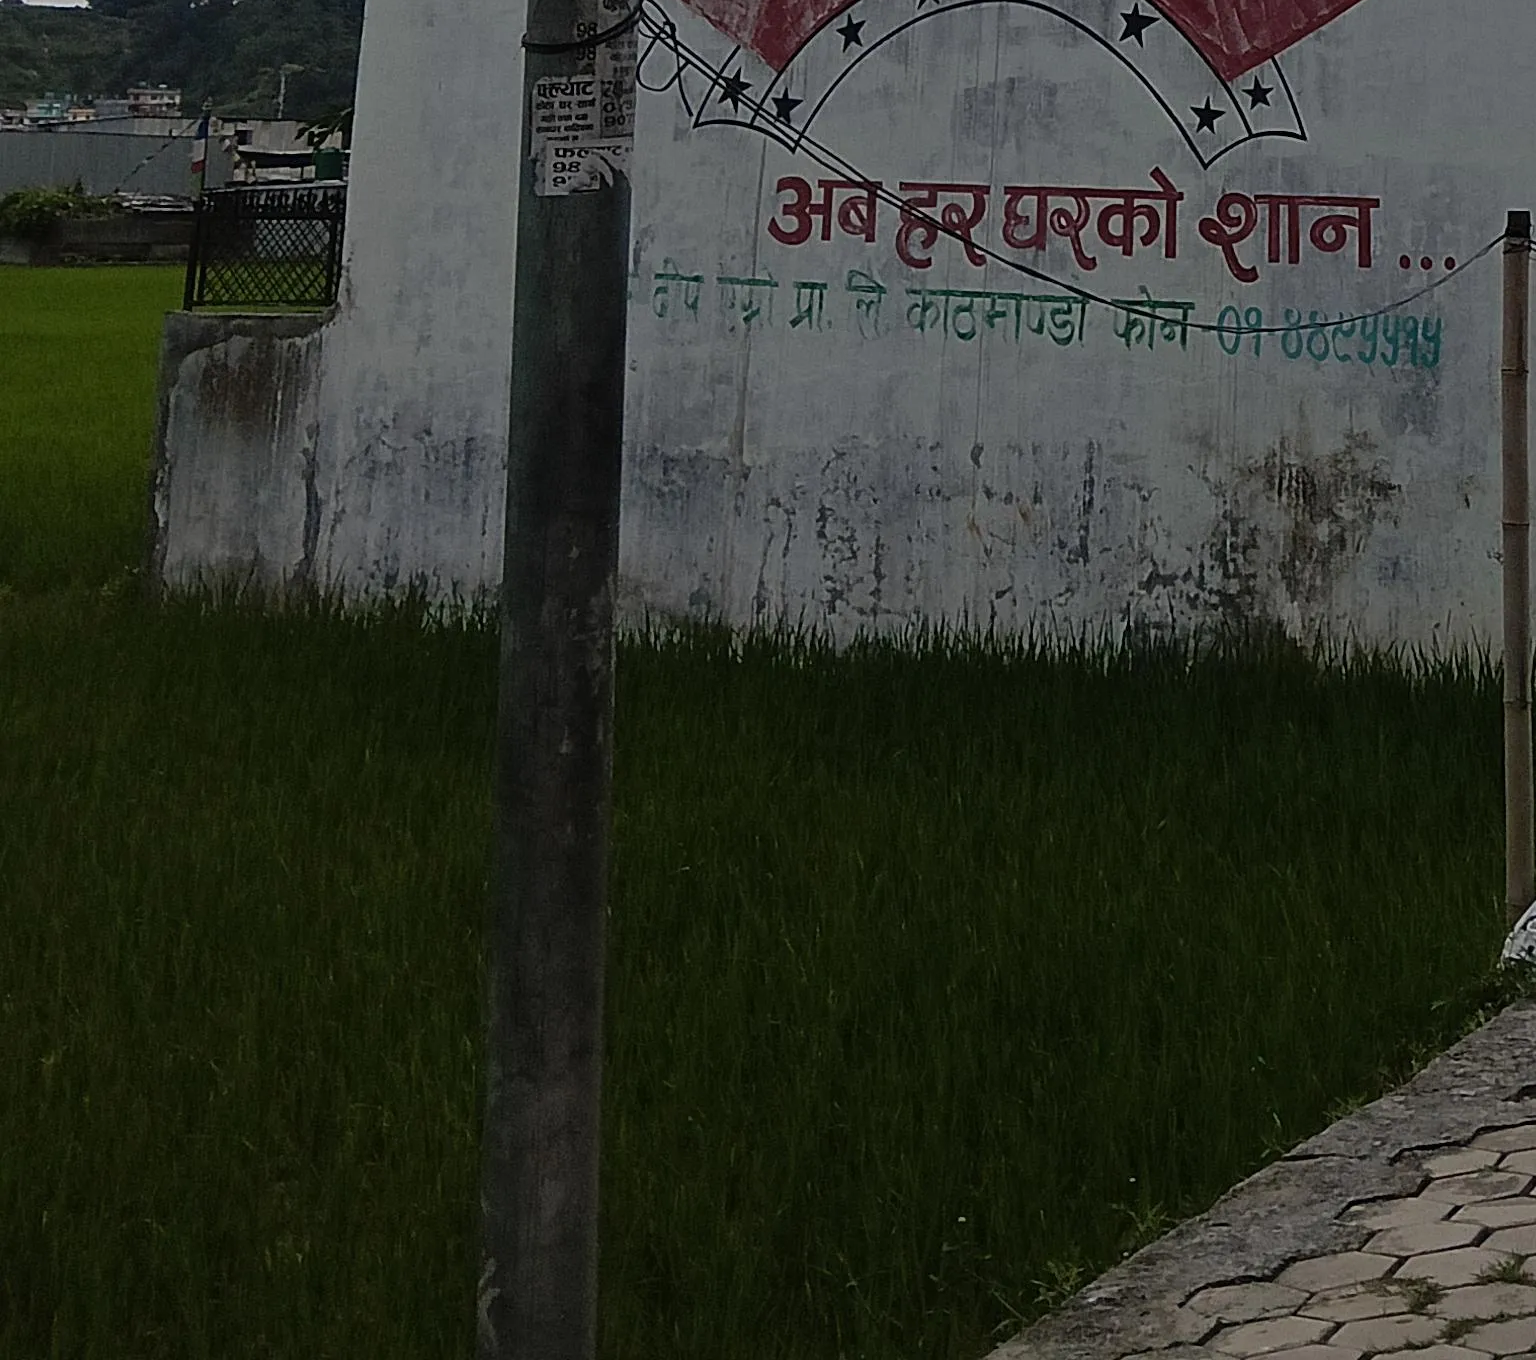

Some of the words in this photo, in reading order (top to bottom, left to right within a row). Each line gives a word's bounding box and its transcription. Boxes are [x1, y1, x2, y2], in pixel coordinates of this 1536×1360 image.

[767, 176, 884, 246] अब
[896, 182, 991, 270] हर
[1002, 166, 1184, 272] घरको
[1198, 192, 1381, 284] शान
